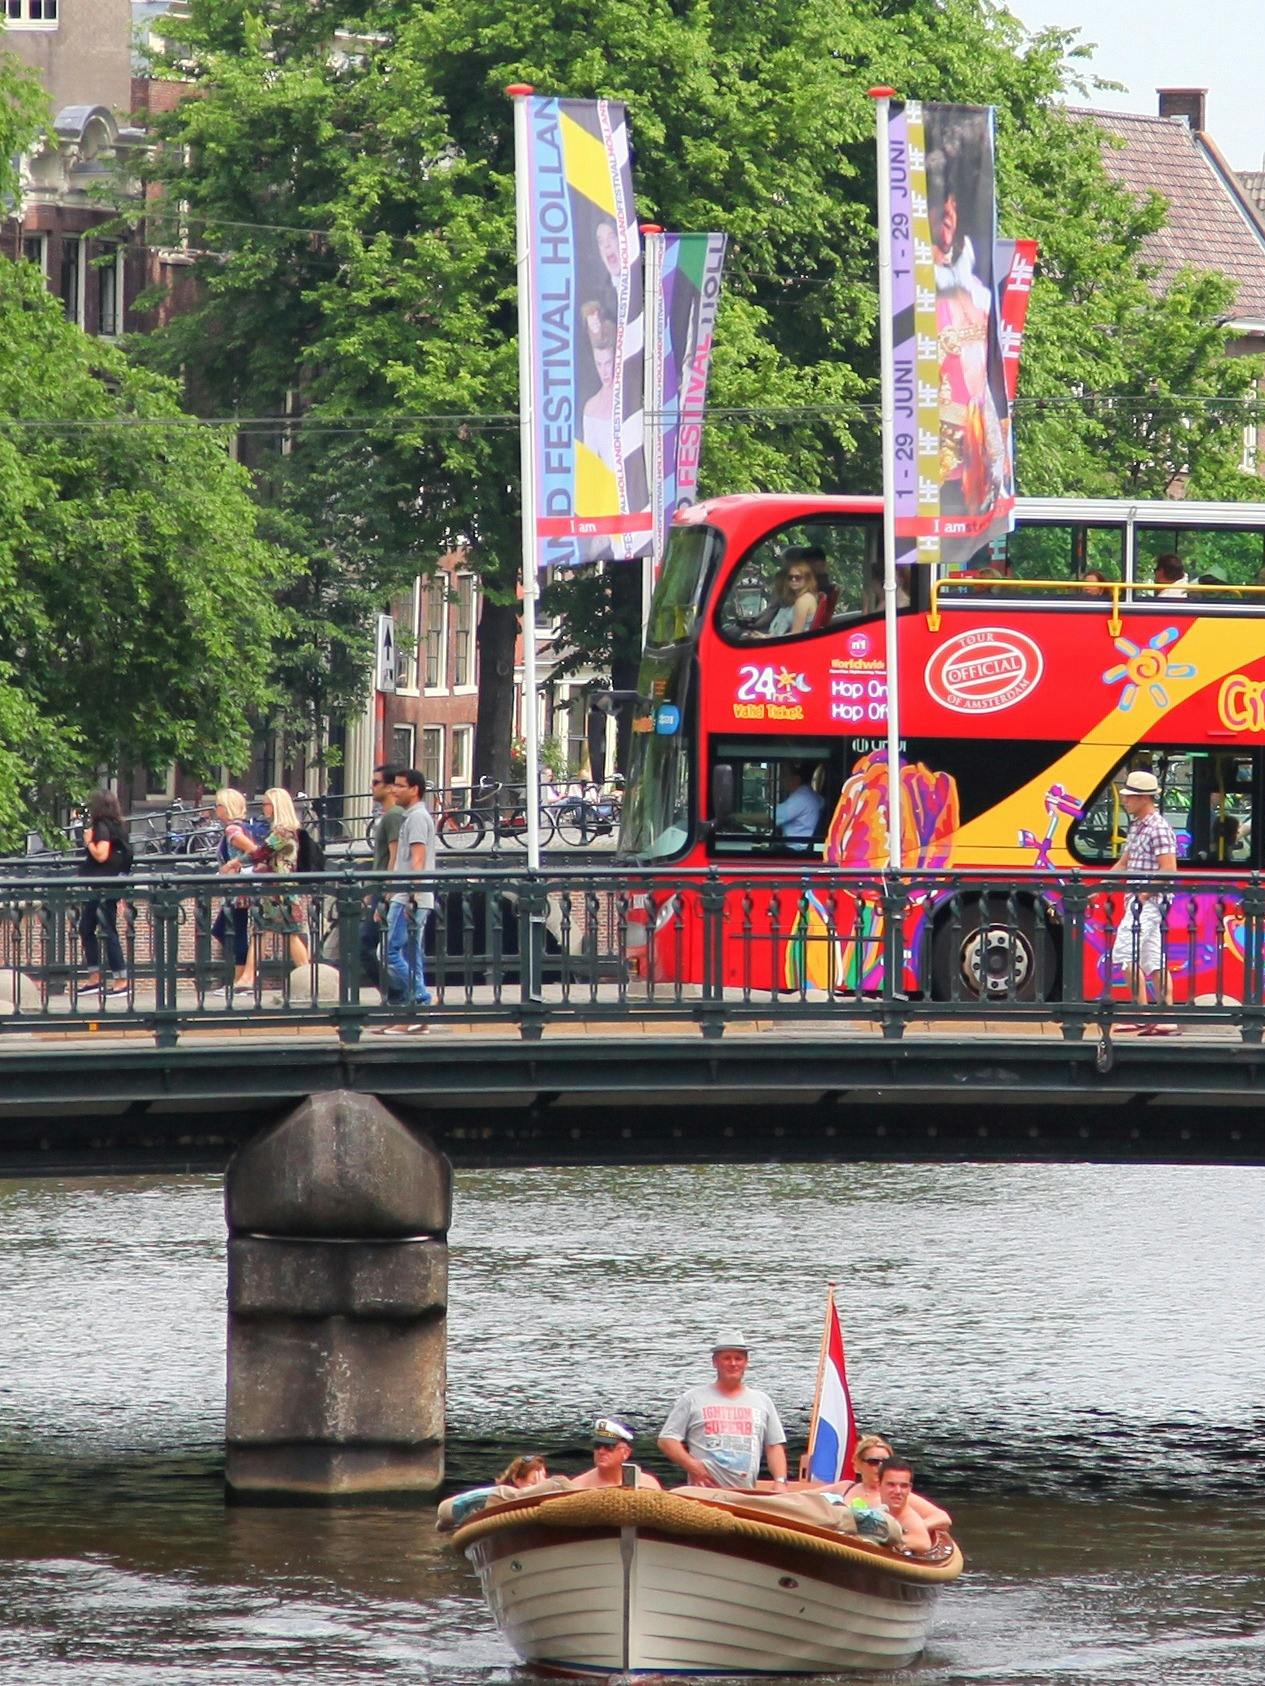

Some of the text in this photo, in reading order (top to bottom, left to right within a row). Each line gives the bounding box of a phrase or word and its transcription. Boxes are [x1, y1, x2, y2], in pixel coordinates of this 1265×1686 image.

[889, 140, 908, 198] JUNI
[891, 213, 909, 240] 29
[893, 270, 910, 278] 1
[542, 278, 572, 474] FESTIVAL
[894, 360, 914, 418] JUNI
[679, 334, 711, 486] FESTIVAL
[895, 433, 913, 460] 29
[896, 490, 913, 498] 1
[579, 523, 597, 532] am
[959, 632, 995, 648] TOUR
[738, 666, 776, 700] 24
[948, 657, 1021, 683] OFFICIAL
[831, 681, 863, 699] Hop
[946, 678, 1030, 709] OF AMSTERDAM
[831, 703, 864, 721] Hop
